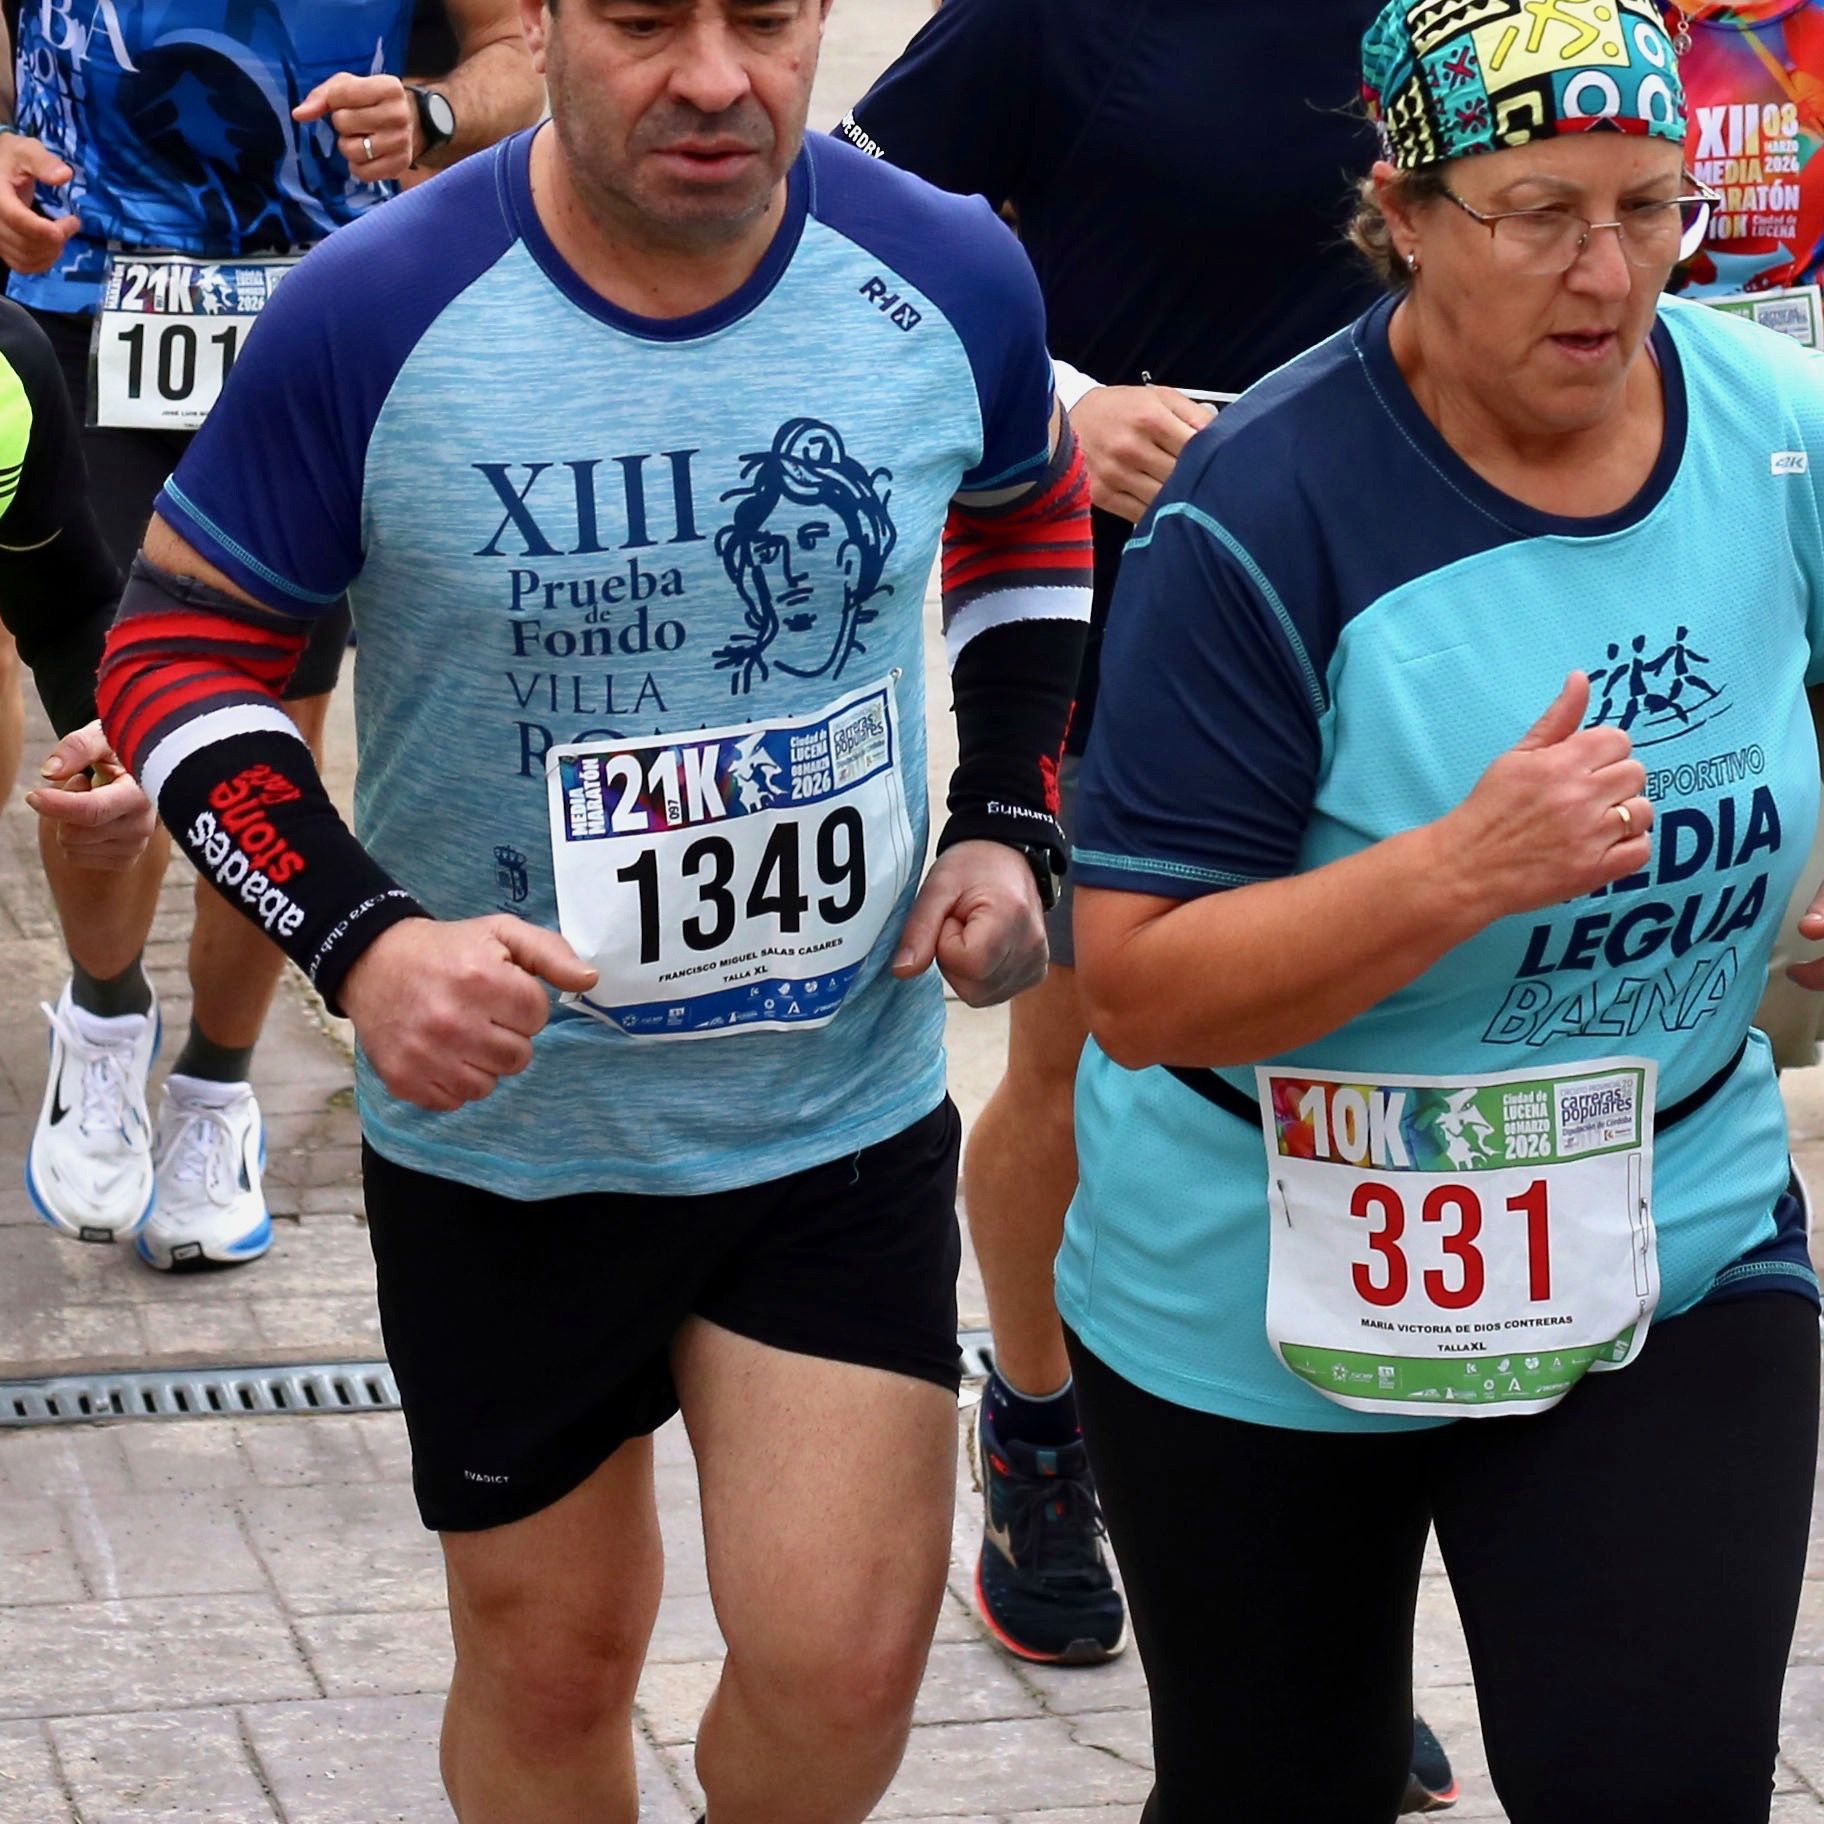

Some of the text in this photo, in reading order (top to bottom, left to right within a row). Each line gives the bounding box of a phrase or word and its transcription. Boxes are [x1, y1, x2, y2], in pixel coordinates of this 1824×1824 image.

[1696, 103, 1760, 160] XII
[1762, 103, 1799, 138] 08
[1765, 140, 1799, 154] MARZO
[1694, 158, 1763, 184] MEDIA
[1765, 156, 1799, 173] 2026
[1715, 179, 1800, 212] ARATÓN
[1752, 225, 1796, 239] LUCENA
[1753, 215, 1797, 225] Ciudad de
[121, 264, 193, 313] 21K
[472, 448, 707, 557] XIII
[507, 560, 686, 611] Prueba
[512, 605, 687, 658] Fondo
[584, 605, 611, 624] de
[506, 671, 670, 714] VILLA
[790, 729, 827, 747] Ciudad de
[833, 714, 873, 743] carreras
[835, 721, 884, 759] populares
[791, 741, 828, 762] LUCENA
[605, 744, 728, 833] 21K
[792, 770, 831, 800] 2026
[1633, 743, 1766, 802] EPORTIVO
[570, 786, 588, 836] MEDIA
[584, 757, 606, 835] MARATÓN
[209, 782, 307, 885] stone
[186, 810, 305, 938] abades
[616, 805, 867, 965] 1349
[319, 920, 348, 954] club
[1516, 874, 1771, 979] LEGUA
[659, 937, 843, 983] FRANCISCO MIGUEL SALAS CASARES
[723, 965, 768, 983] TALLA XL
[1482, 946, 1740, 1047] BAENA
[1503, 1090, 1547, 1104] Ciudad de
[1503, 1104, 1548, 1121] LUCENA
[1561, 1088, 1621, 1109] carreras
[1562, 1098, 1632, 1126] populares
[1299, 1085, 1411, 1168] 10K
[1505, 1133, 1551, 1160] 2026
[1349, 1179, 1552, 1310] 331
[1361, 1315, 1573, 1334] MARIA VICTORIA DE DIOS CONTRERAS
[1437, 1342, 1486, 1352] TALLA XL
[464, 1469, 510, 1485] EVADICT
